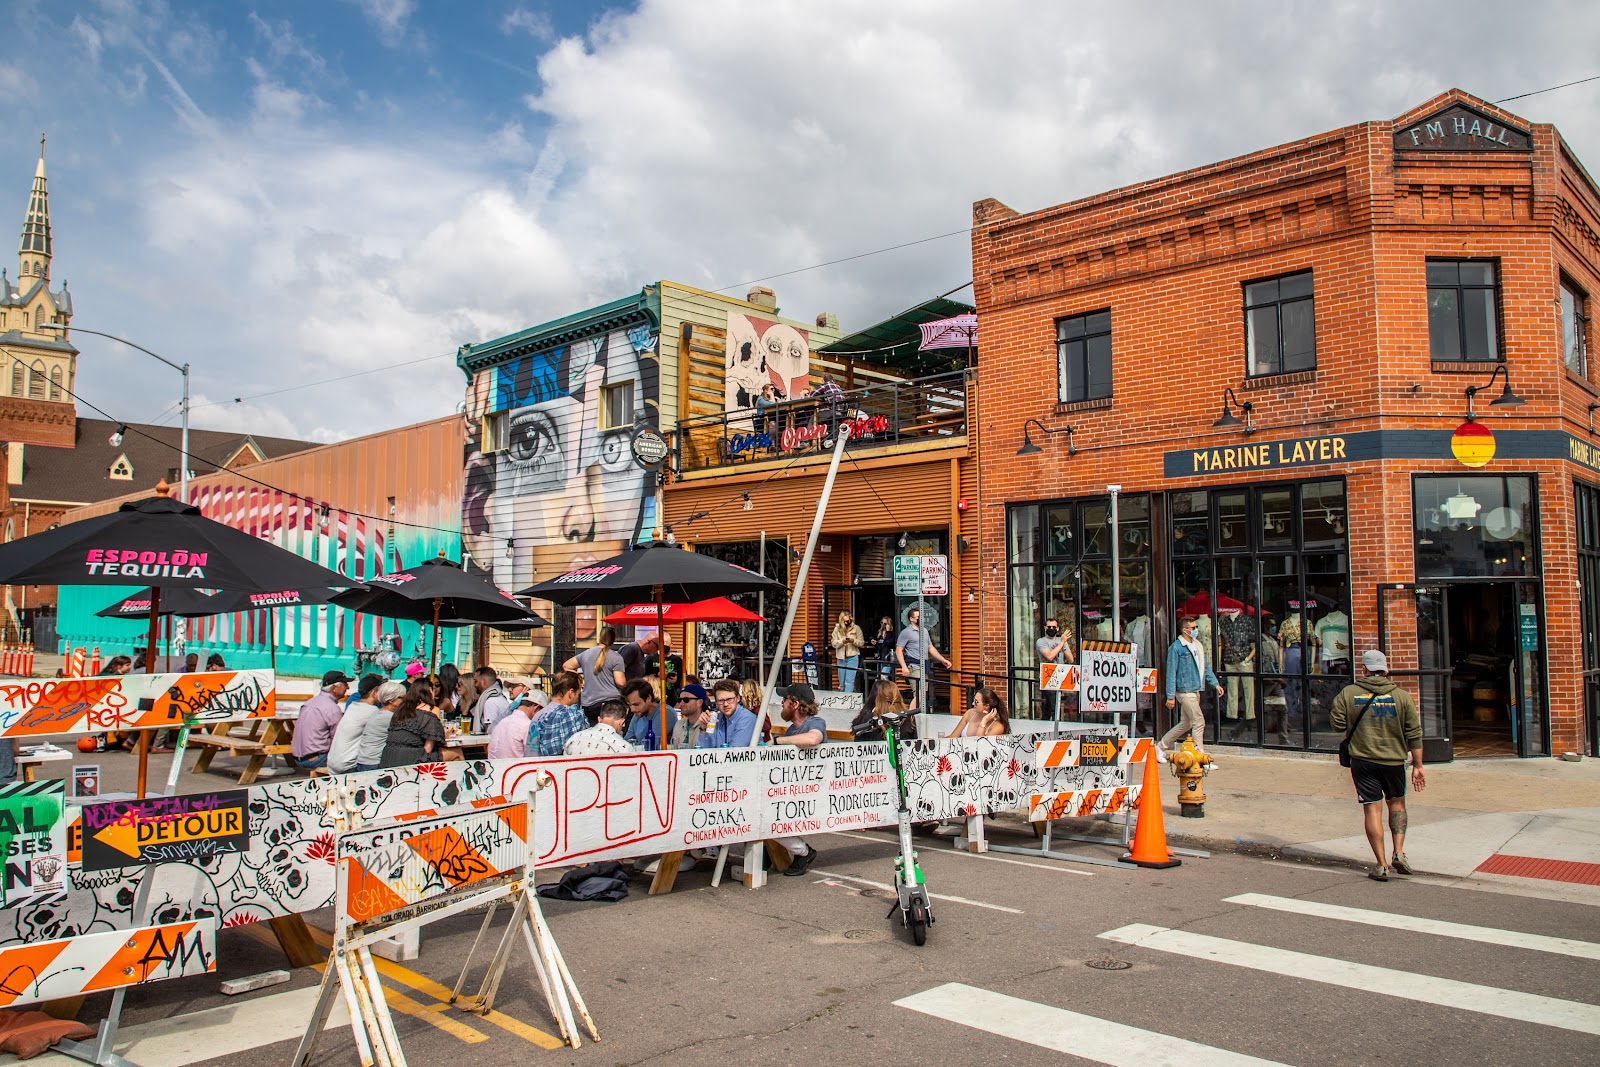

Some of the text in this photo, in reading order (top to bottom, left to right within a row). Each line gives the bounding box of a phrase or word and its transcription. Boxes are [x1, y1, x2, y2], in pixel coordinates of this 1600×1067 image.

[1453, 118, 1510, 146] HALL
[1193, 438, 1346, 472] MARINE LAYER
[1570, 438, 1589, 465] MARINE
[86, 562, 205, 578] TEQUILA
[896, 559, 901, 570] 2
[554, 574, 608, 583] TEQUILA
[252, 597, 301, 606] TEQUILA
[1093, 660, 1127, 677] ROAD
[1087, 685, 1131, 702] CLOSED
[724, 750, 756, 762] AWARD
[760, 749, 795, 761] WINNING
[798, 747, 817, 760] CHEF
[820, 746, 854, 759] CURATED
[1082, 745, 1108, 756] DETOUR
[769, 765, 824, 784] CHAVEZ
[834, 759, 885, 778] BLAUVELT
[702, 771, 732, 793] LEE
[768, 784, 820, 797] CHILE RELLENO
[829, 775, 887, 790] MEATLOAF SANDWICH
[731, 788, 747, 802] DIP
[829, 792, 889, 814] RODRIGUEZ
[511, 761, 672, 859] OPEN
[692, 807, 746, 829] OSAKA
[772, 800, 816, 821] TORU
[864, 812, 881, 823] PIBIL
[138, 812, 239, 842] DETOUR
[771, 820, 820, 834] PORK KATSU
[684, 829, 716, 844] CHICKEN
[381, 909, 414, 923] COLORADO
[417, 900, 449, 916] BARRICADE
